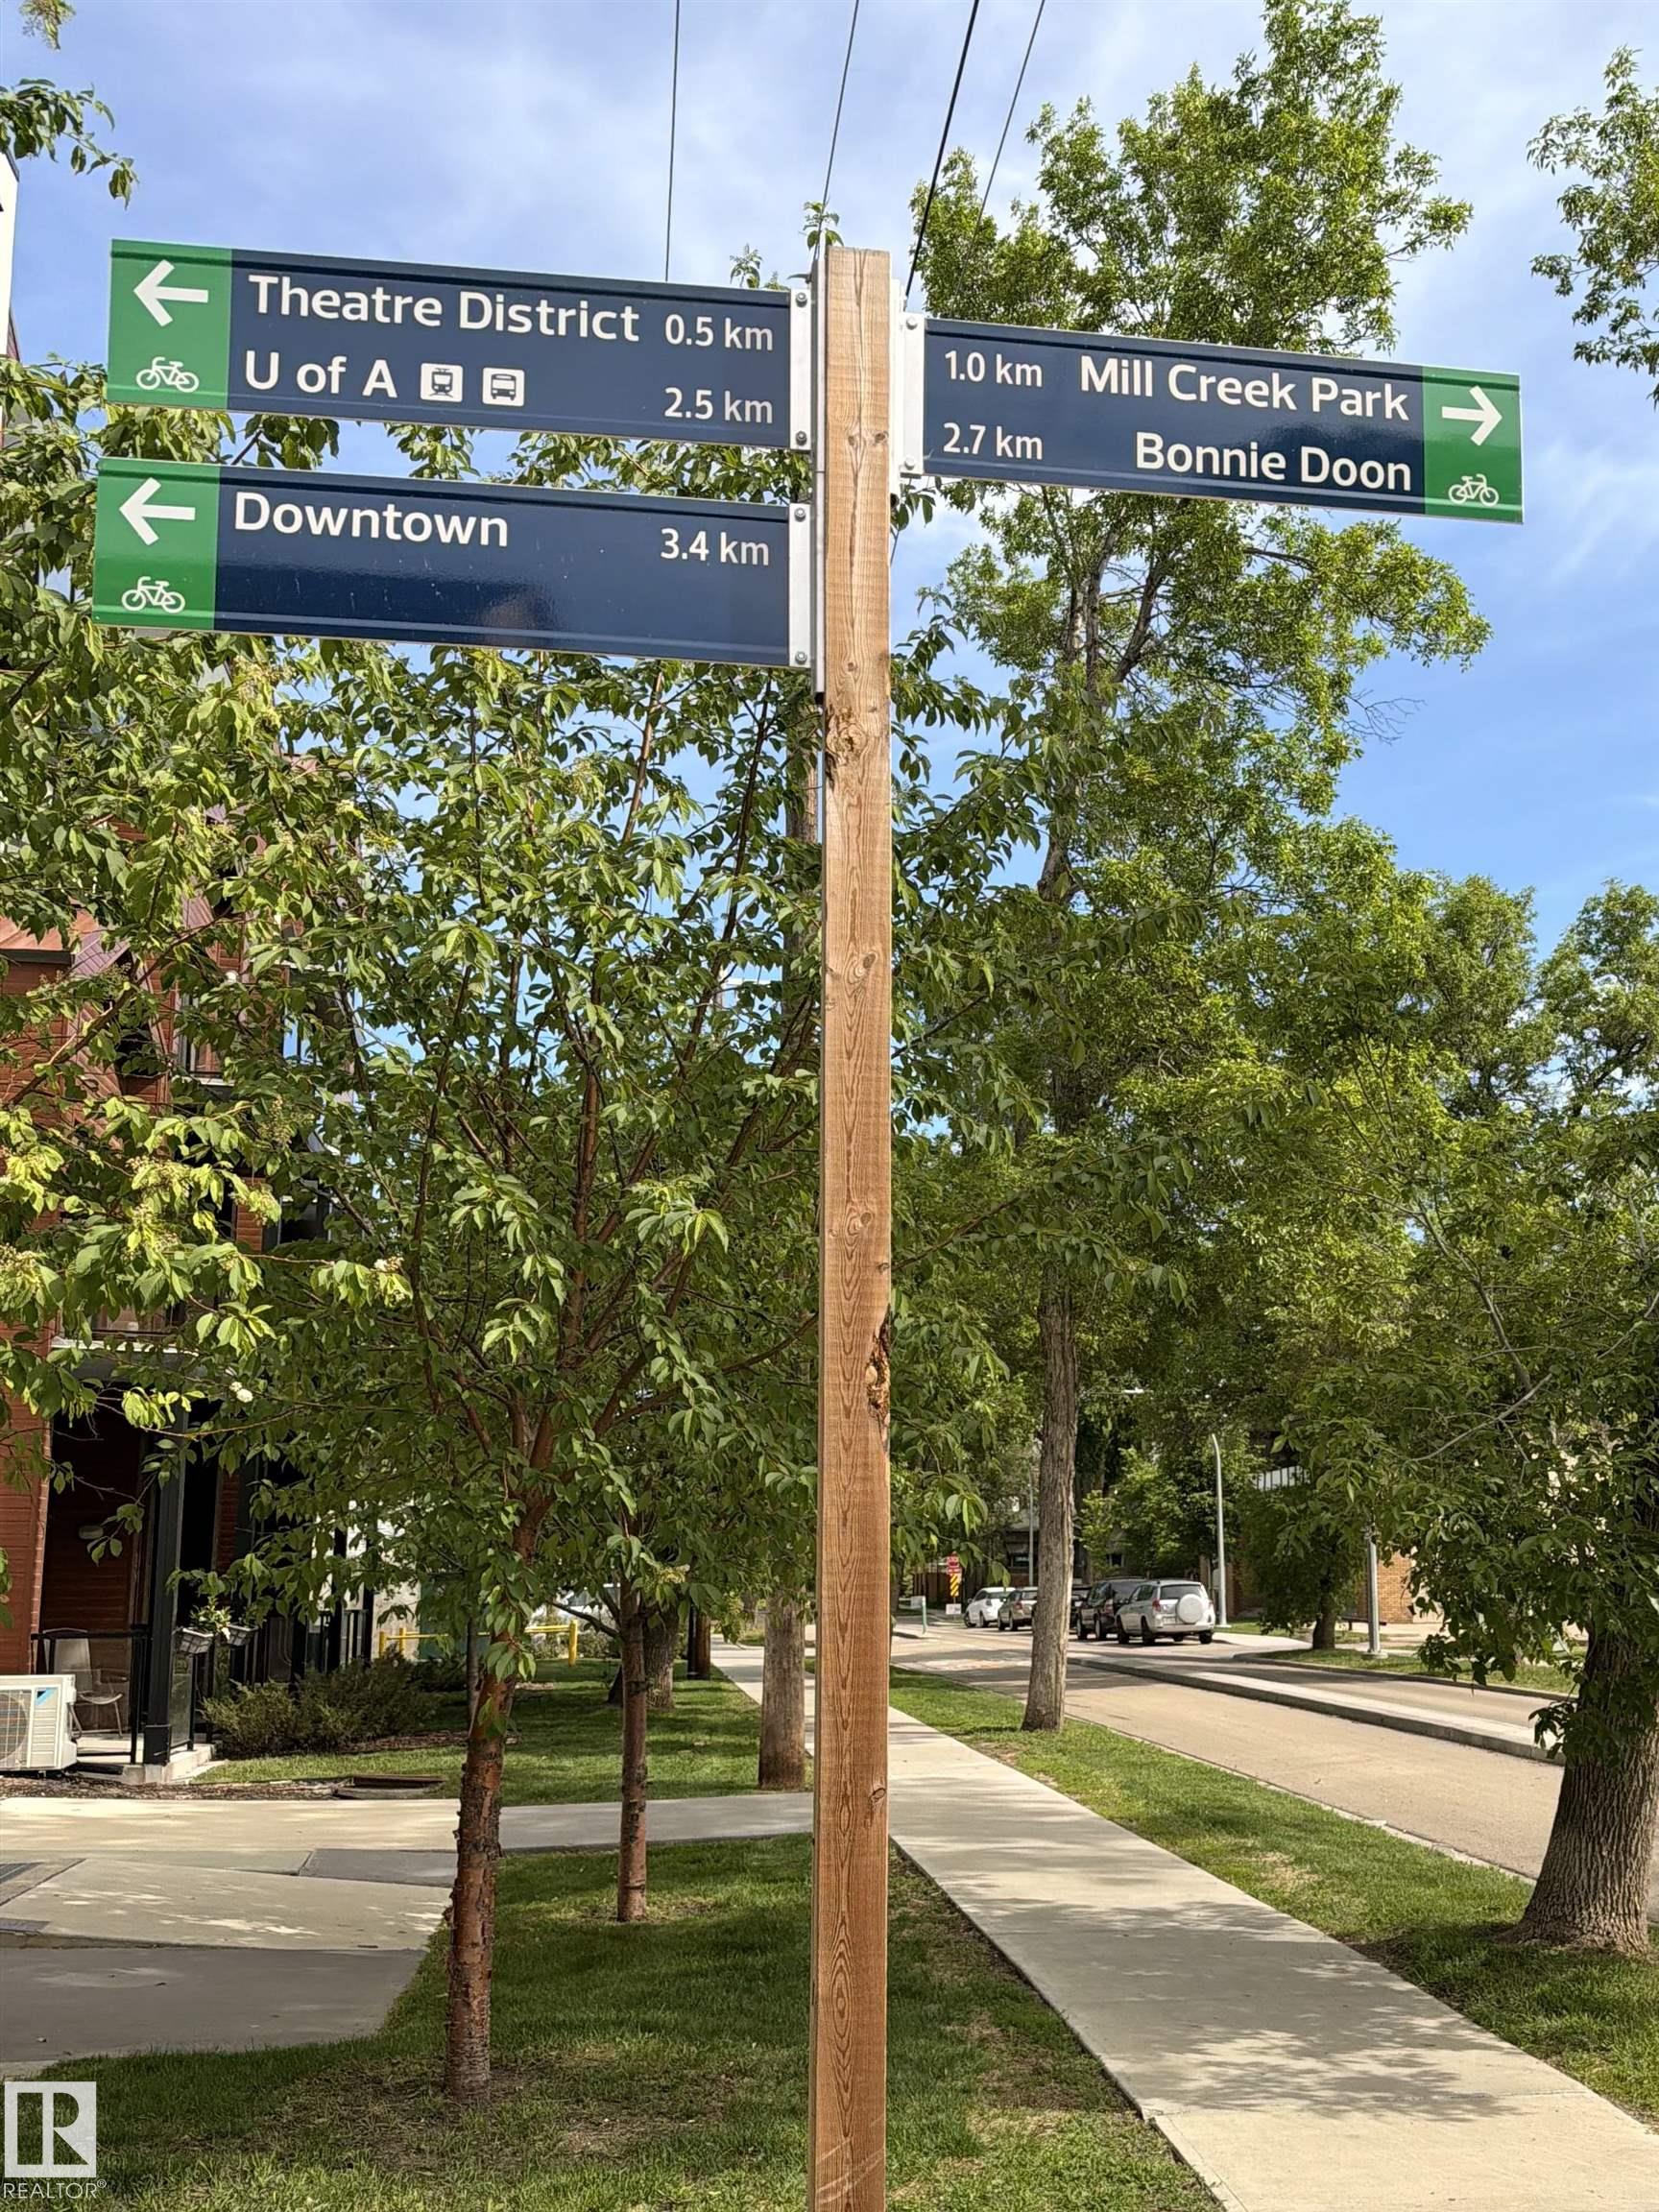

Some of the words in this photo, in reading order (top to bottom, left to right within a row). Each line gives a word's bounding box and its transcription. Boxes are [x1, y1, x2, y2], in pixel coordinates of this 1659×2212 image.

[248, 274, 443, 327] Theatre
[459, 291, 639, 343] District
[664, 314, 714, 347] 0.5
[724, 317, 774, 352] km
[245, 349, 279, 391] U
[296, 355, 348, 395] of
[362, 359, 398, 398] A
[664, 387, 713, 421] 2.5
[724, 390, 773, 424] km
[945, 349, 986, 382] 1.0
[996, 353, 1043, 388] km
[1080, 354, 1153, 397] Mill
[1167, 363, 1298, 411] Creek
[1311, 376, 1409, 421] Park
[943, 421, 986, 455] 2.7
[996, 425, 1043, 461] km
[1136, 431, 1286, 481] Bonnie
[1301, 445, 1411, 492] Doon
[234, 491, 508, 547] Downtown
[660, 527, 710, 562] 3.4
[720, 531, 769, 566] km
